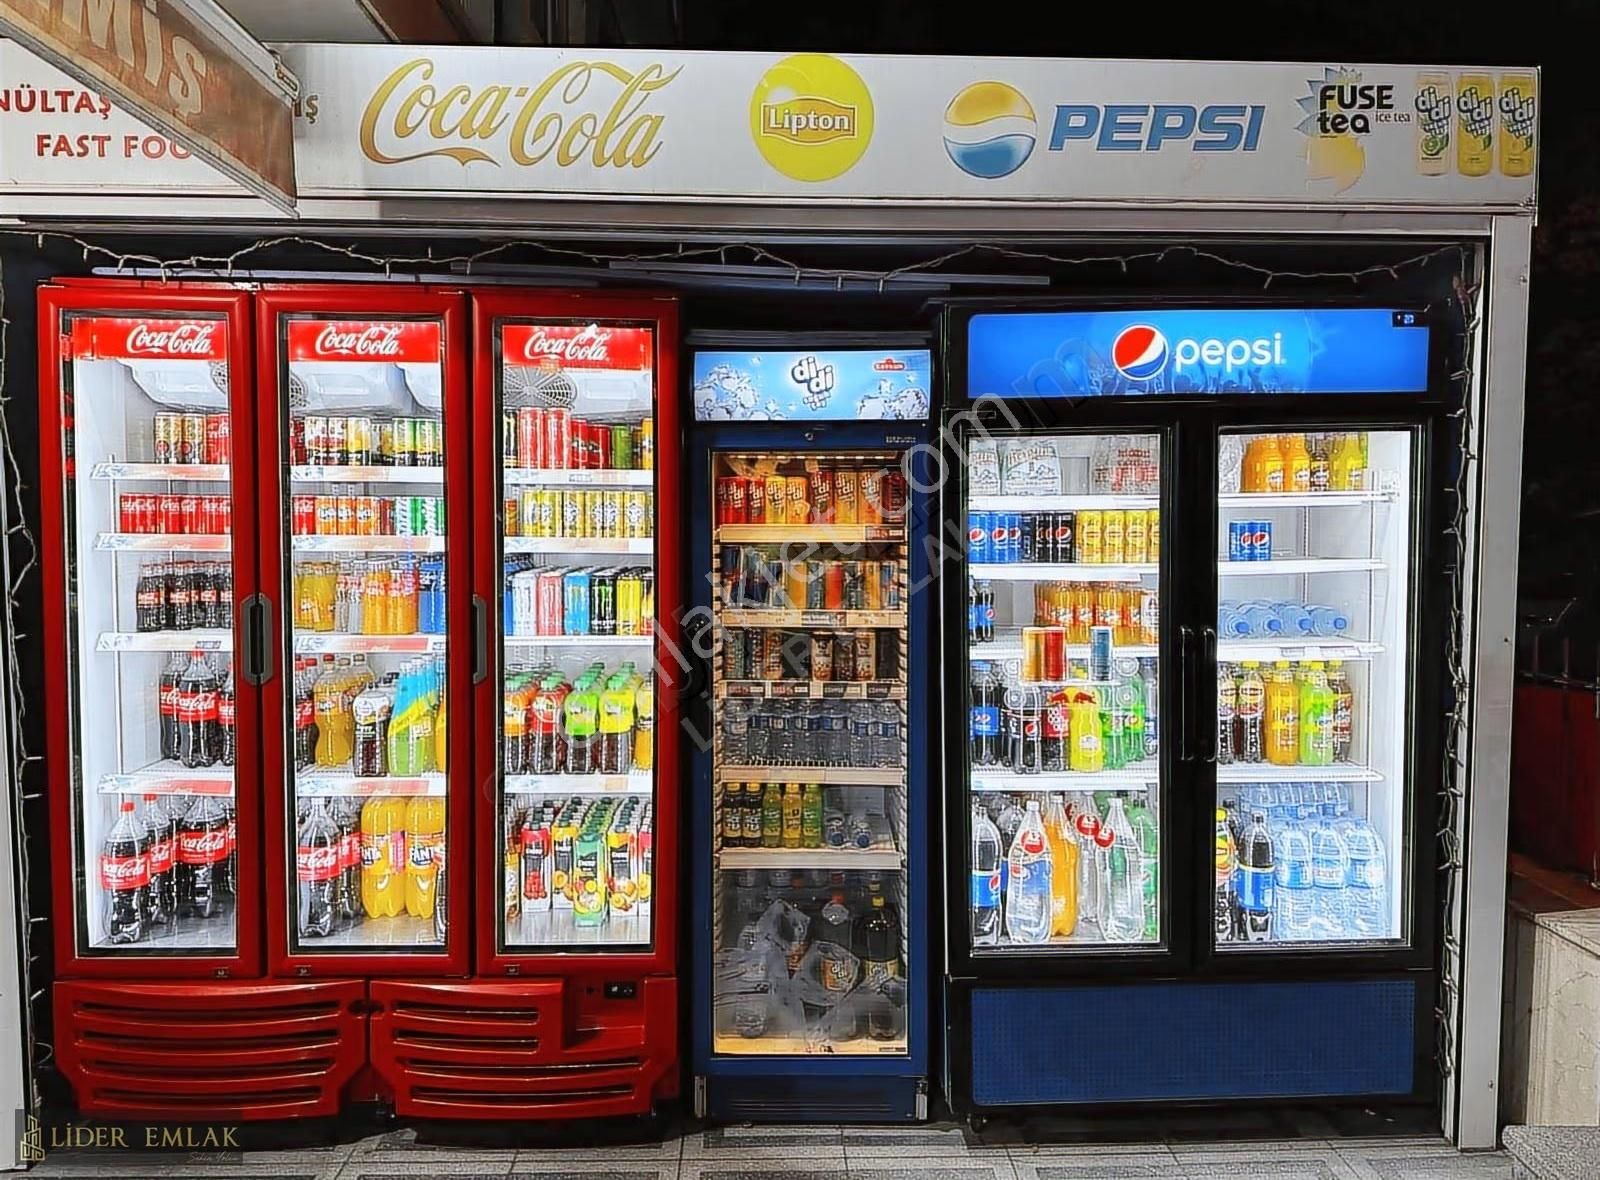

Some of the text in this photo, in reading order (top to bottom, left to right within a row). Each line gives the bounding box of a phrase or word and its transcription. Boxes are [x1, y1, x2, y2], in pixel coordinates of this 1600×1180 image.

[1319, 85, 1394, 110] FUSE
[360, 58, 684, 168] Coca-Cola
[769, 108, 850, 134] Lipton
[1048, 104, 1266, 151] PEPSI
[1316, 112, 1371, 134] tea
[1375, 111, 1411, 123] ice tea
[36, 134, 111, 157] FAST
[126, 322, 214, 354] Coca-Cola
[315, 326, 403, 356] Coca-Cola
[524, 329, 612, 361] Coca-Cola
[1175, 332, 1284, 373] pepsi
